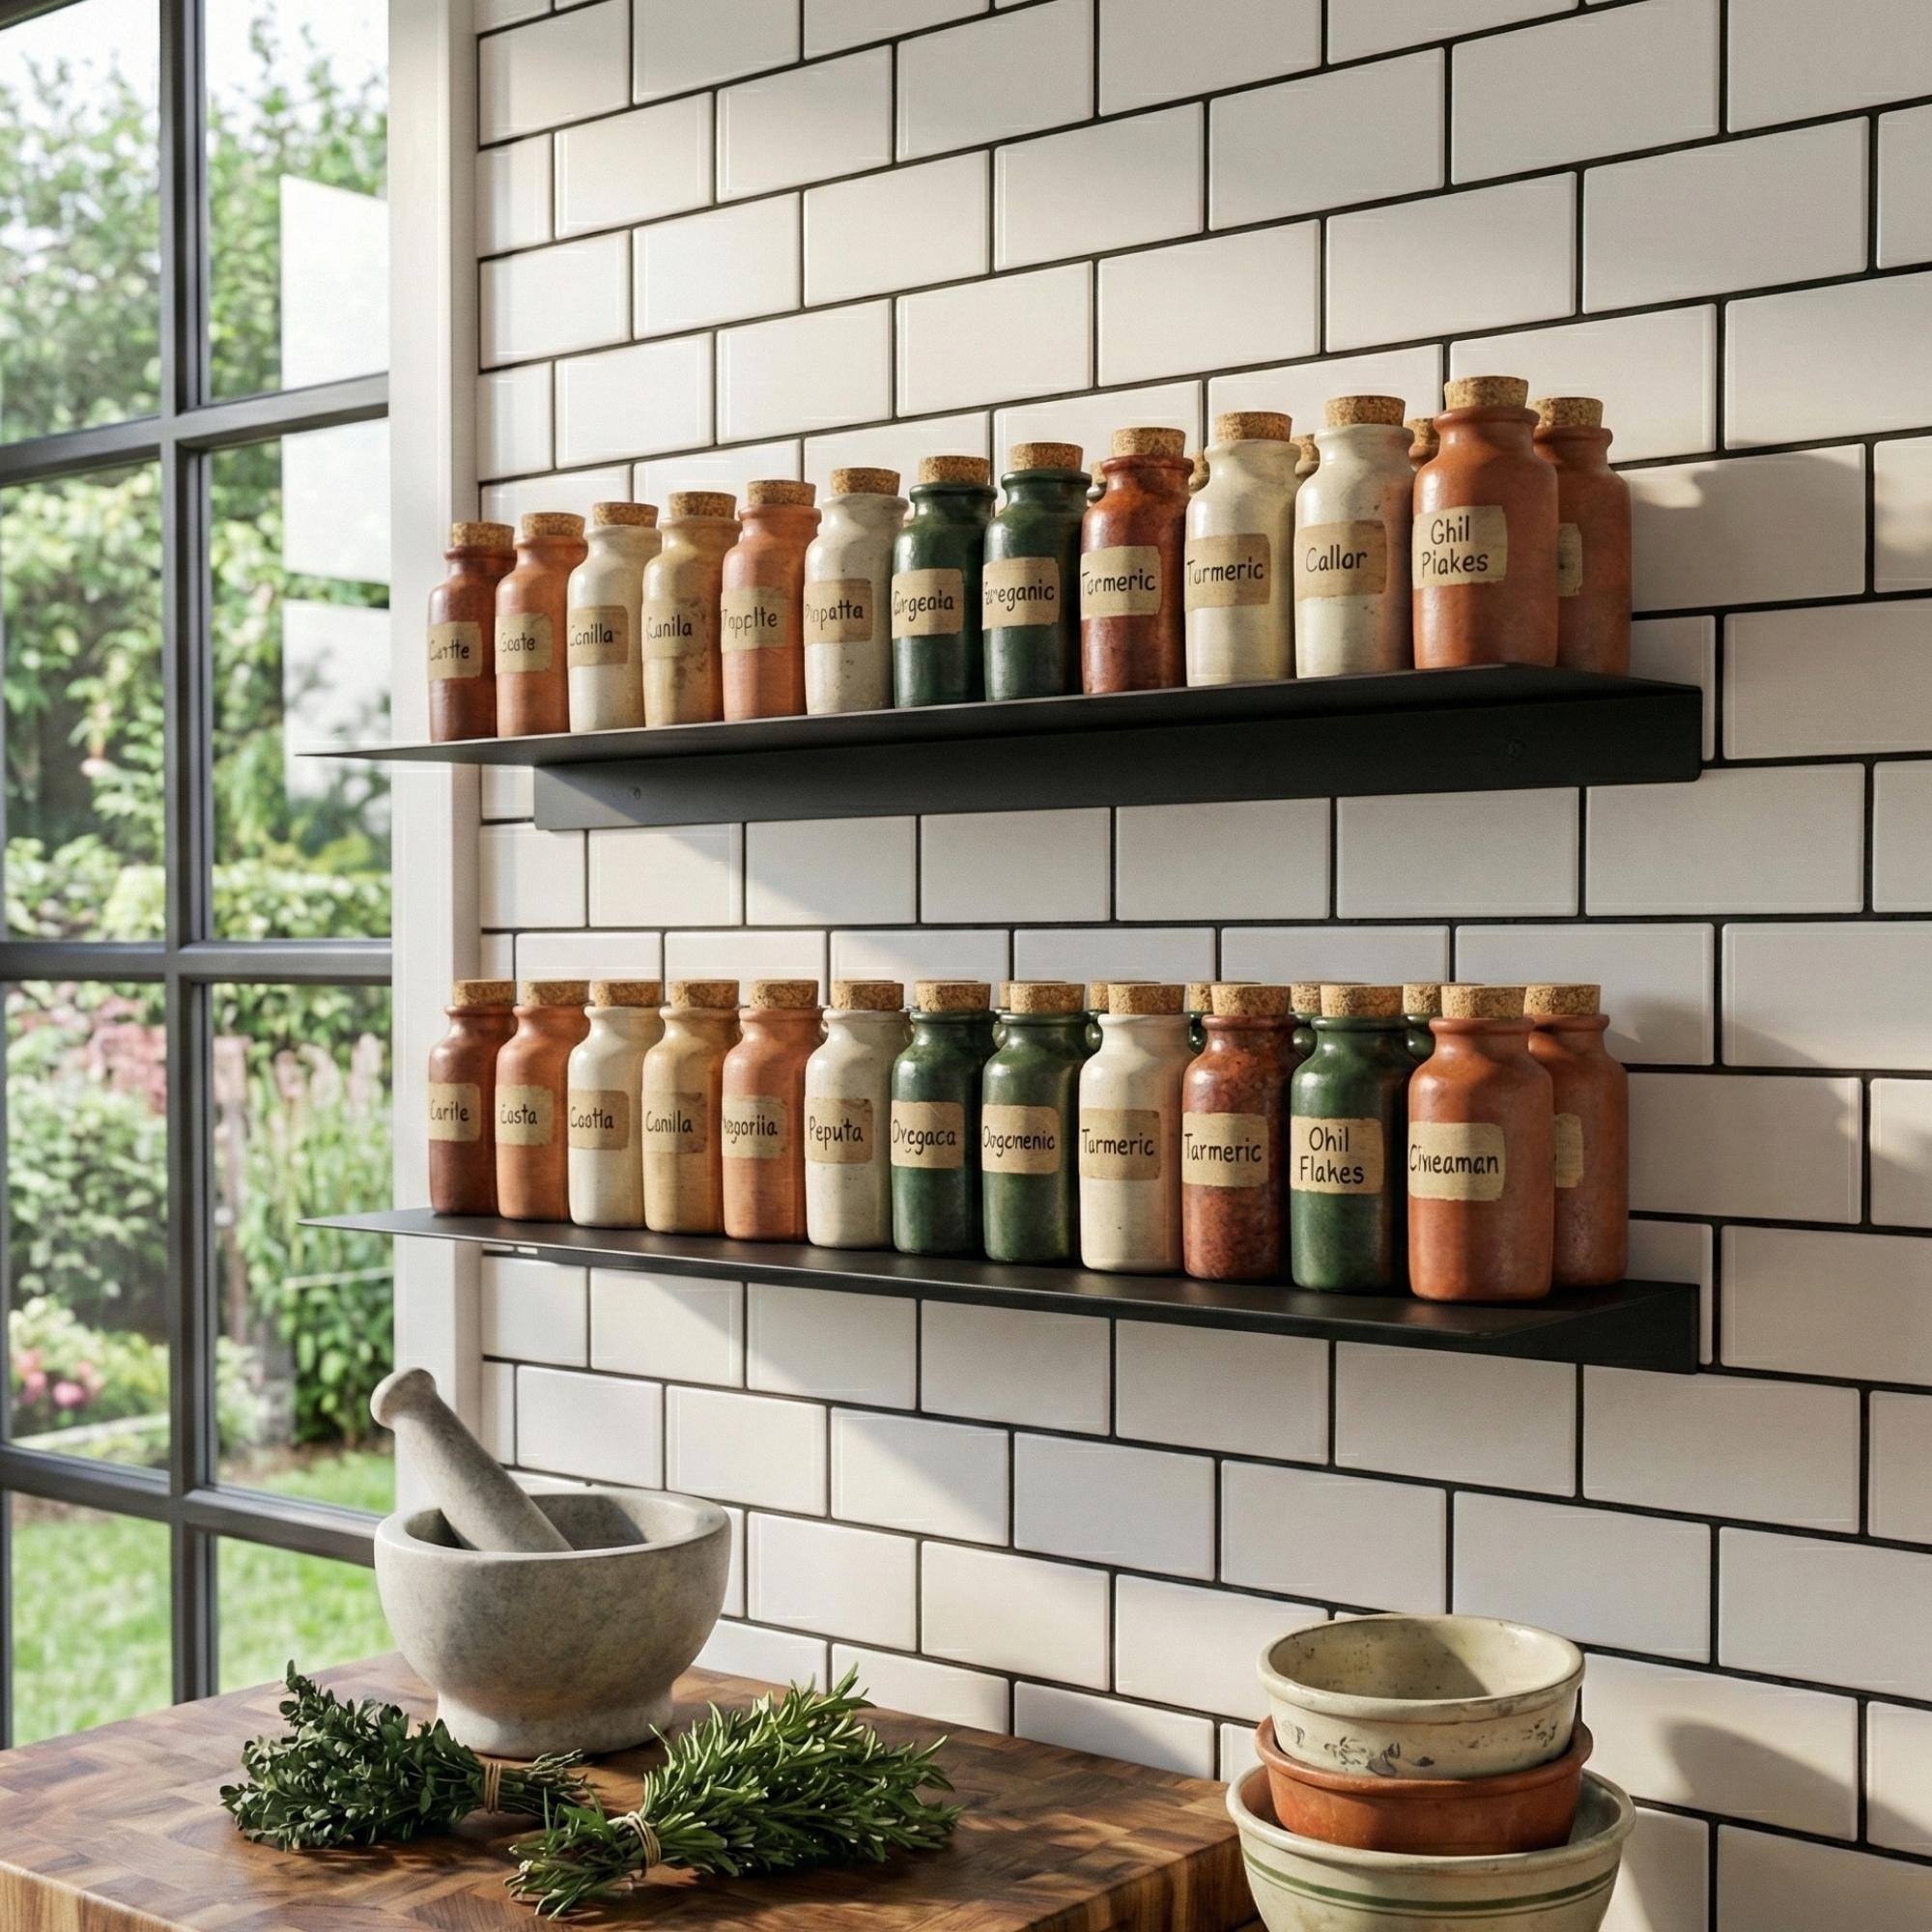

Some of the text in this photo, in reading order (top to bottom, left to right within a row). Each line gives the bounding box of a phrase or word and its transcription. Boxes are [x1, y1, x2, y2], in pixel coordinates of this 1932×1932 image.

[1431, 515, 1469, 545] Ghil
[1309, 1126, 1350, 1152] Ohil
[1300, 1156, 1364, 1184] Flakes
